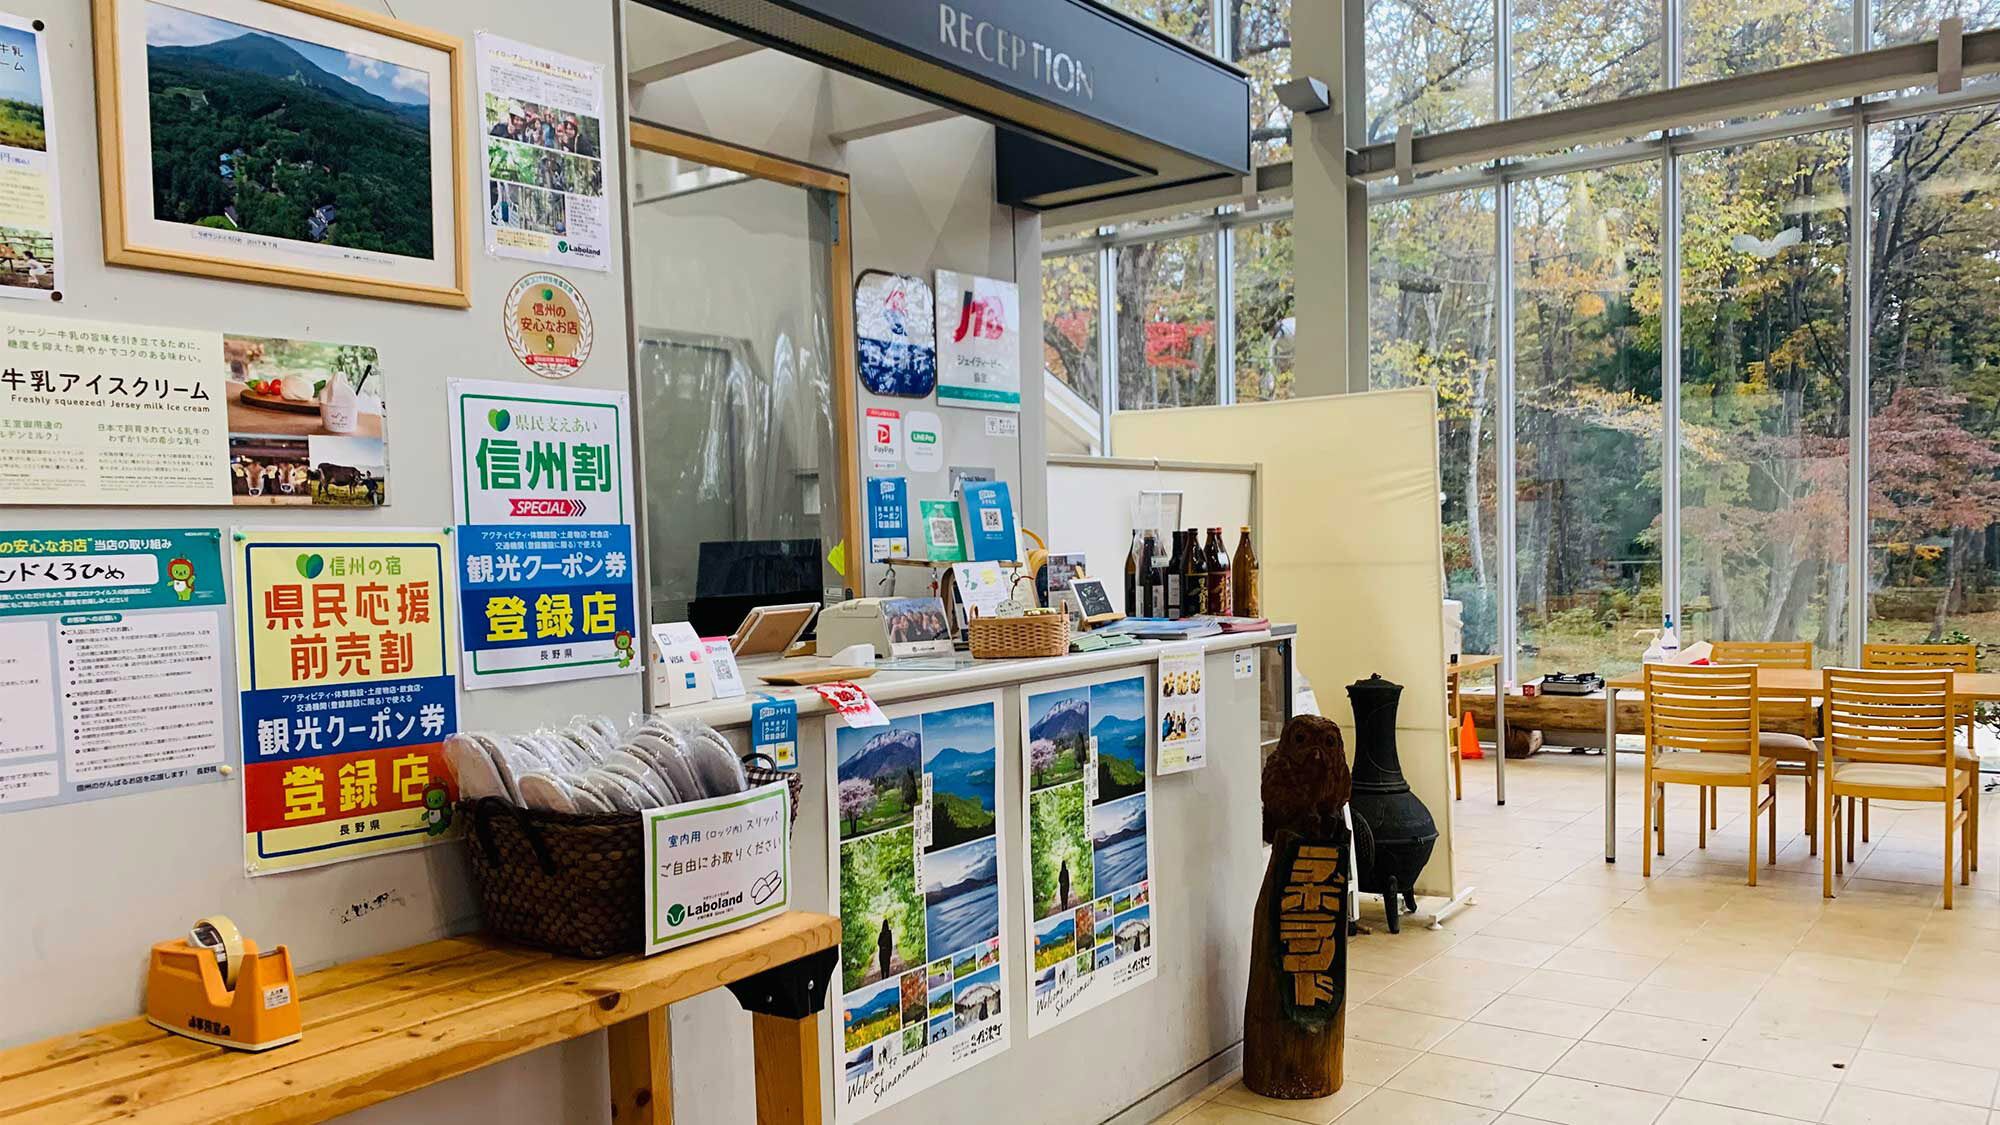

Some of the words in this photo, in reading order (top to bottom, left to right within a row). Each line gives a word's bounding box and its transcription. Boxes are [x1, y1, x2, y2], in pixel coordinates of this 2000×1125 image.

[939, 3, 1094, 101] RECEPTION
[569, 244, 601, 256] Laboland
[532, 303, 566, 318] 信州の
[520, 317, 578, 335] 安心なお店
[1, 368, 210, 401] 牛乳アイスクリーム
[11, 394, 50, 405] Freshly
[55, 398, 106, 410] squeezed!
[110, 399, 141, 410] Jersey
[144, 402, 164, 410] milk
[167, 403, 180, 411] Ice
[183, 405, 210, 413] cream
[515, 414, 598, 433] 県民支えあい
[873, 445, 895, 455] PayPay
[475, 438, 612, 493] 信州割
[516, 501, 567, 515] SPECIAL
[94, 539, 173, 551] 当店の取り組み
[329, 556, 401, 576] 信州の宿
[466, 551, 627, 584] 観光クーポン券
[264, 581, 430, 630] 県民応援
[485, 591, 617, 642] 登録店
[290, 630, 413, 681] 前売割
[540, 648, 573, 661] 長野県
[669, 655, 684, 664] VISA
[257, 703, 445, 756] 観光クーポン券
[196, 766, 217, 776] 長野県
[282, 753, 429, 821] 登録店
[339, 819, 380, 836] 長野県
[667, 830, 701, 848] 室内用
[705, 823, 743, 840] (ロッジ内)
[746, 810, 779, 831] スリッパ
[660, 837, 781, 878] ご自由にお取りください
[687, 891, 743, 917] Laboland
[1278, 845, 1346, 1007] ラボランド
[1036, 987, 1064, 1016] Welcome
[847, 1067, 884, 1104] Welcome
[888, 1056, 898, 1069] to
